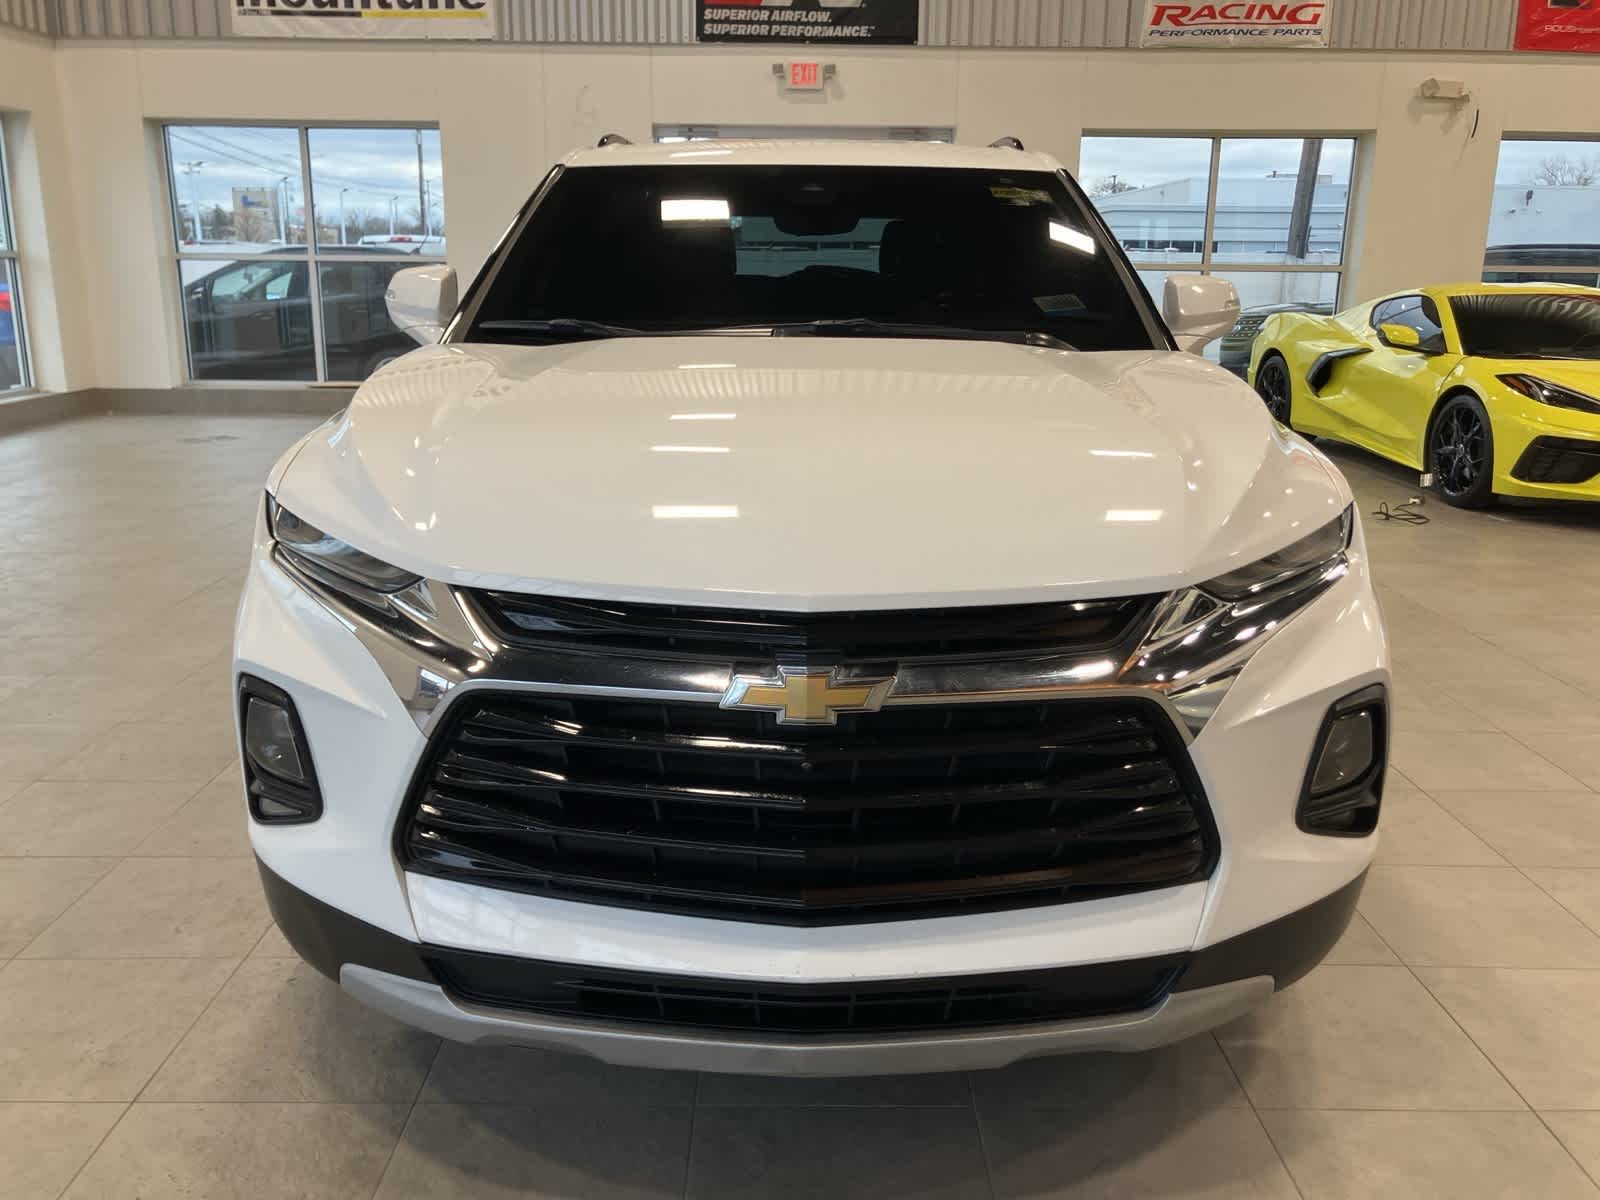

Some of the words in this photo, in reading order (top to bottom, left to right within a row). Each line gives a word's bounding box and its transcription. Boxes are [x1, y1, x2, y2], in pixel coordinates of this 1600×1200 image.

[704, 8, 769, 21] SUPERIOR
[770, 10, 832, 23] AIRFLOW.
[1150, 3, 1325, 27] RACING
[703, 23, 770, 36] SUPERIOR
[1148, 28, 1269, 37] PERFORMANCE
[1272, 28, 1322, 36] PARTS
[791, 63, 819, 86] EXIT
